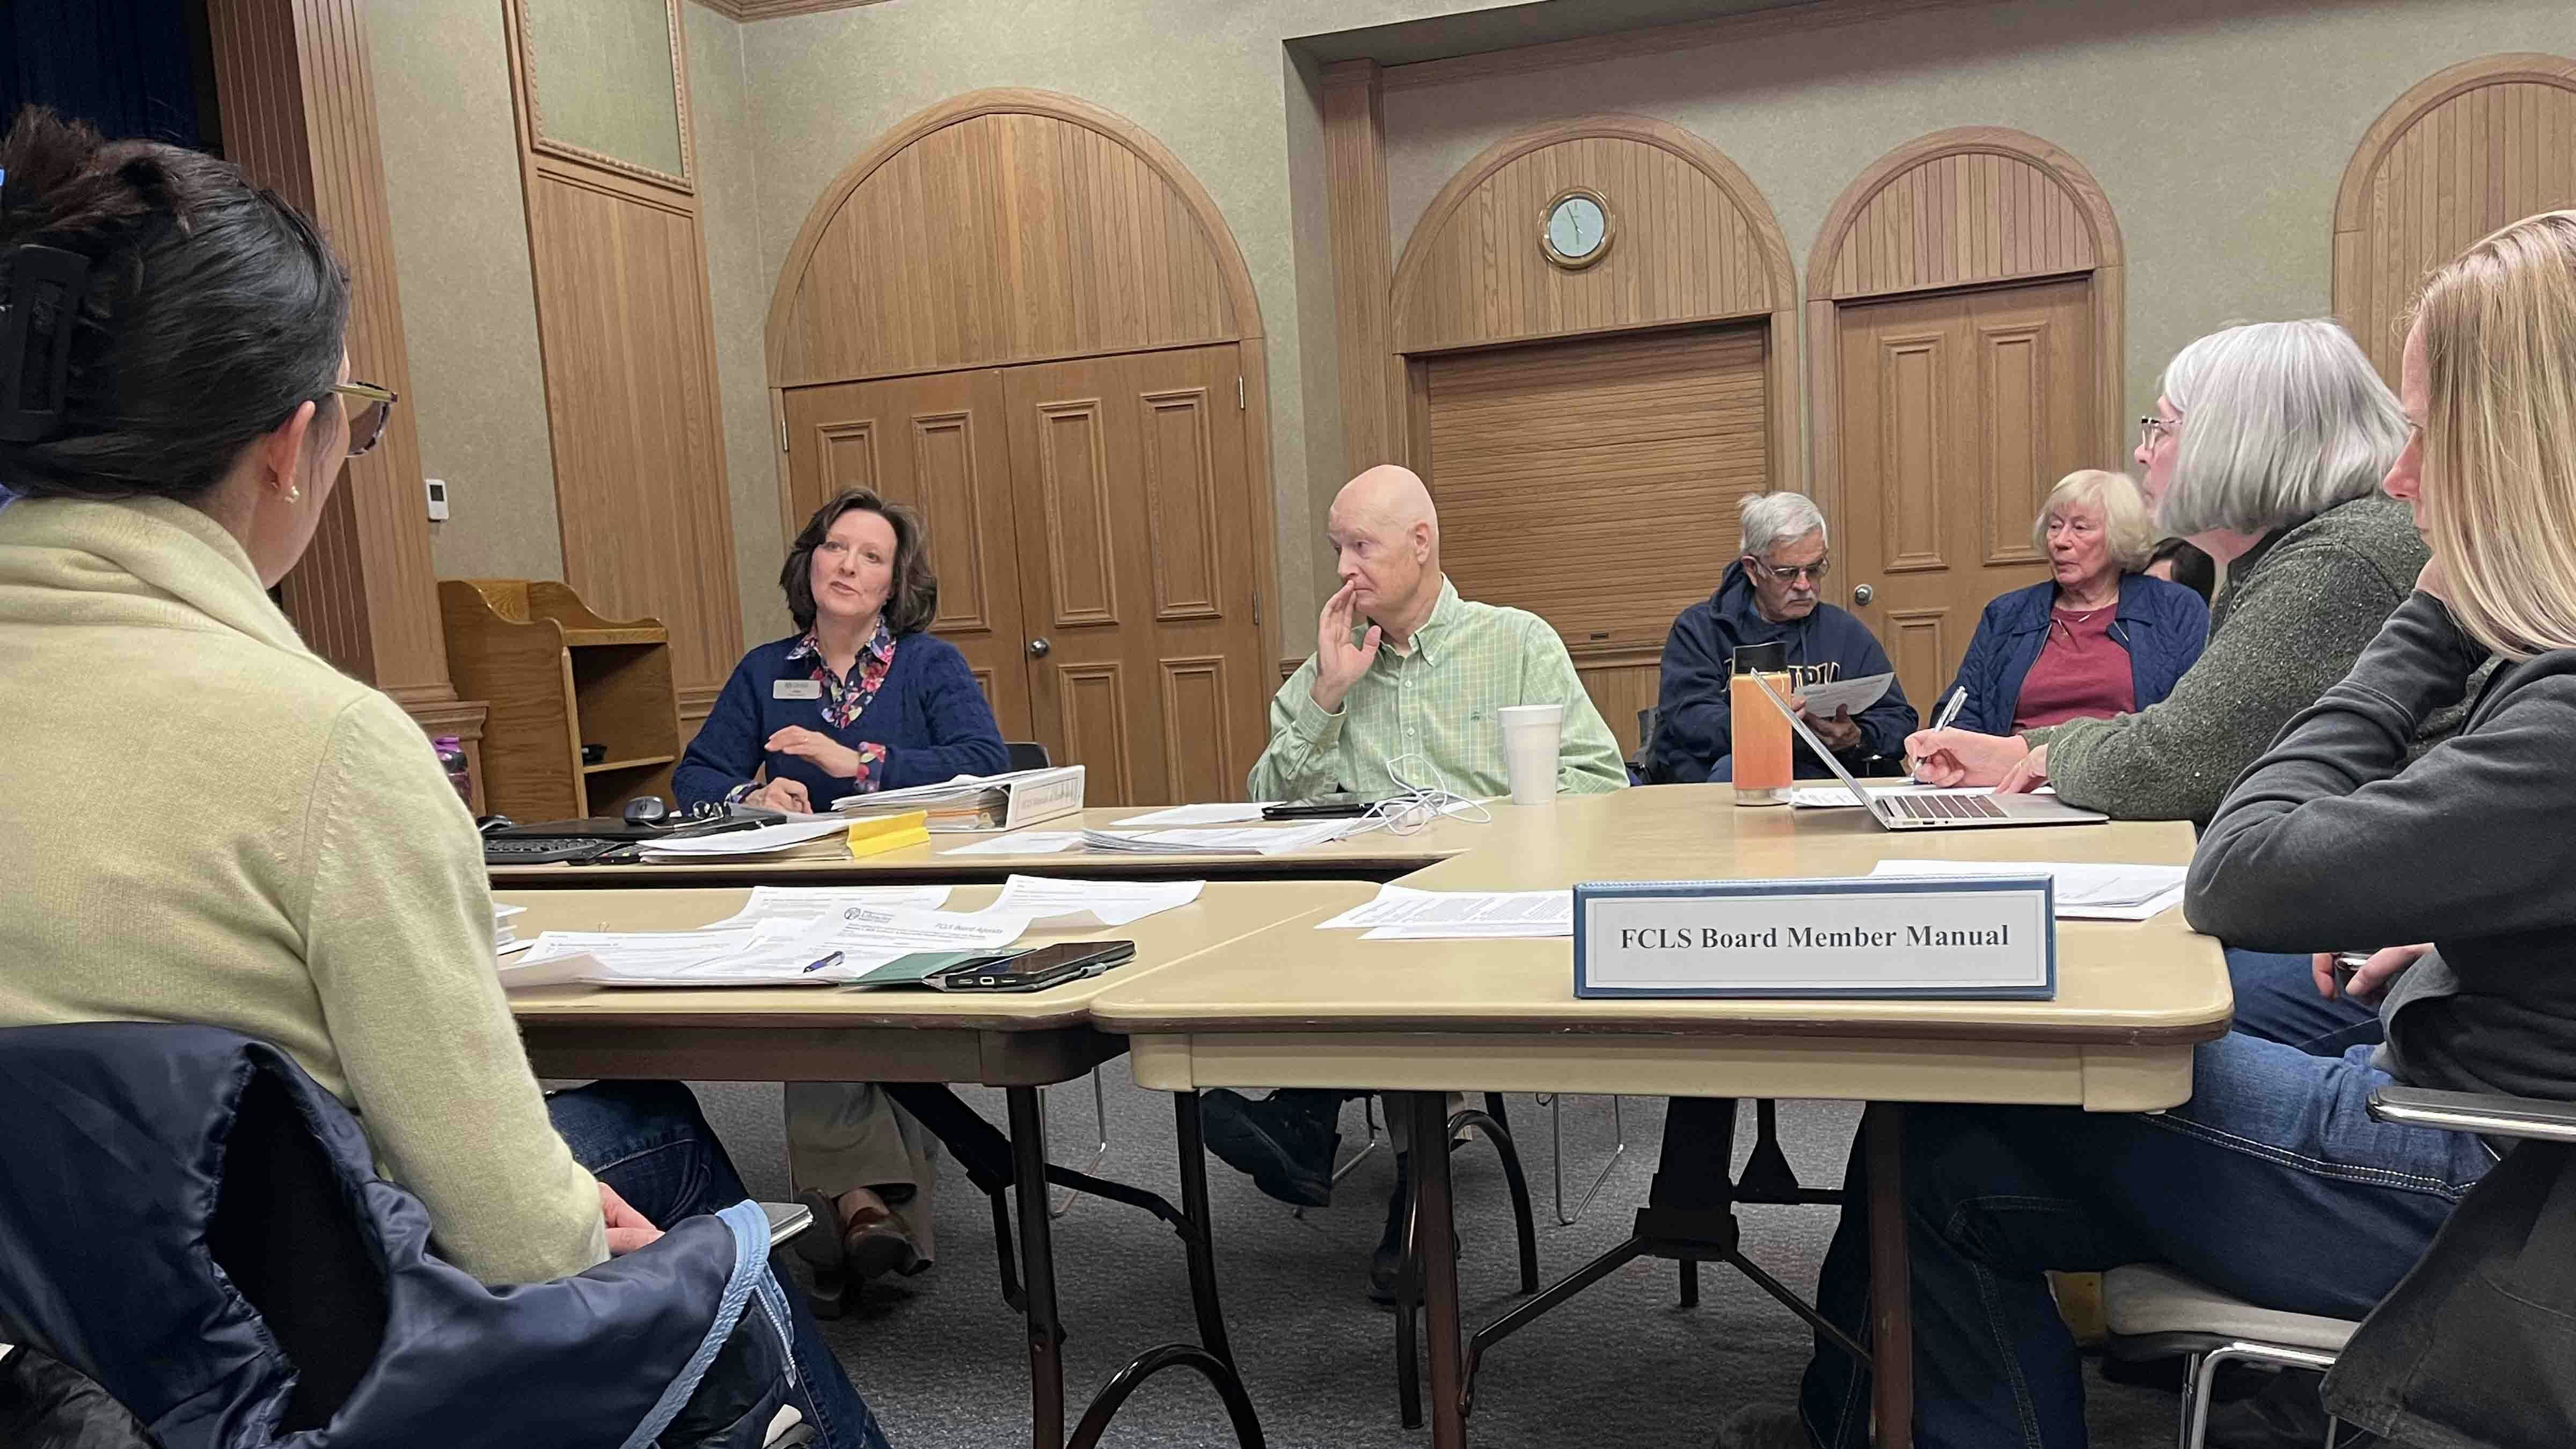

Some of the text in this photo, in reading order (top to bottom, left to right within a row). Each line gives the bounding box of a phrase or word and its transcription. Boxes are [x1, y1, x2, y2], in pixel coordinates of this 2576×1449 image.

[1621, 924, 2010, 948] FCLS Board Member Manual
